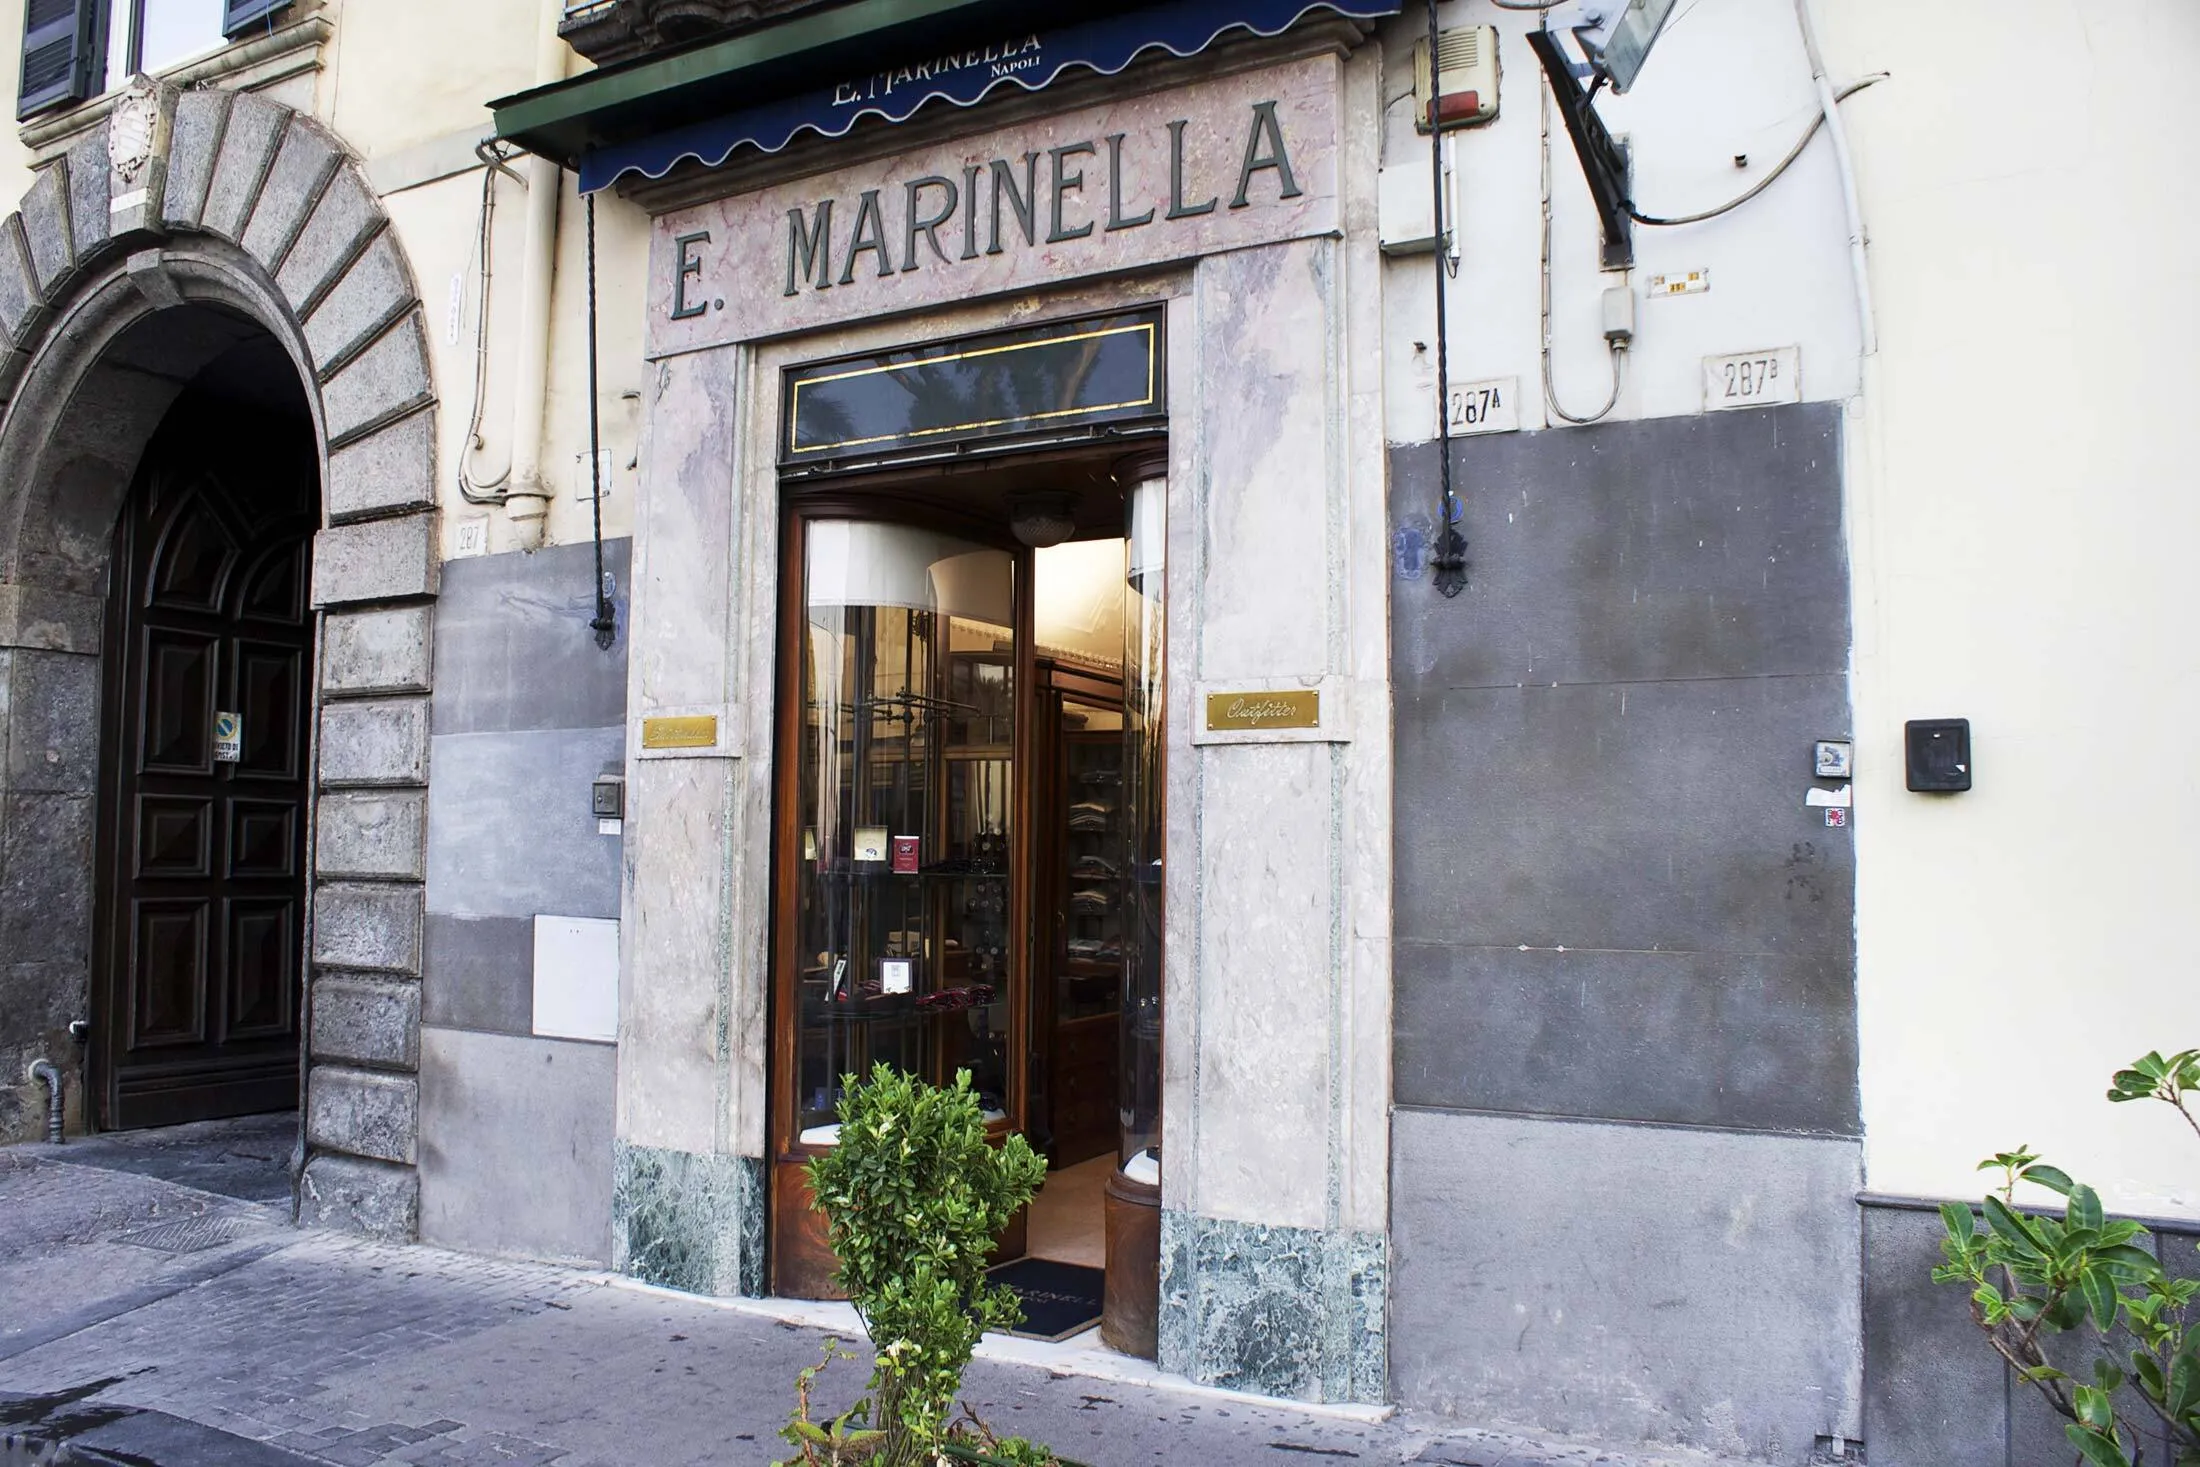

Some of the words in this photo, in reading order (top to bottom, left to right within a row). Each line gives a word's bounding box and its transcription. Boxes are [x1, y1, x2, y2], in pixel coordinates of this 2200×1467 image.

[990, 55, 1041, 79] NAPOLI
[670, 230, 725, 320] E.
[783, 100, 1304, 297] MARINELLA
[1724, 357, 1778, 398] 287B
[1451, 387, 1501, 426] 287A
[459, 526, 480, 550] 287
